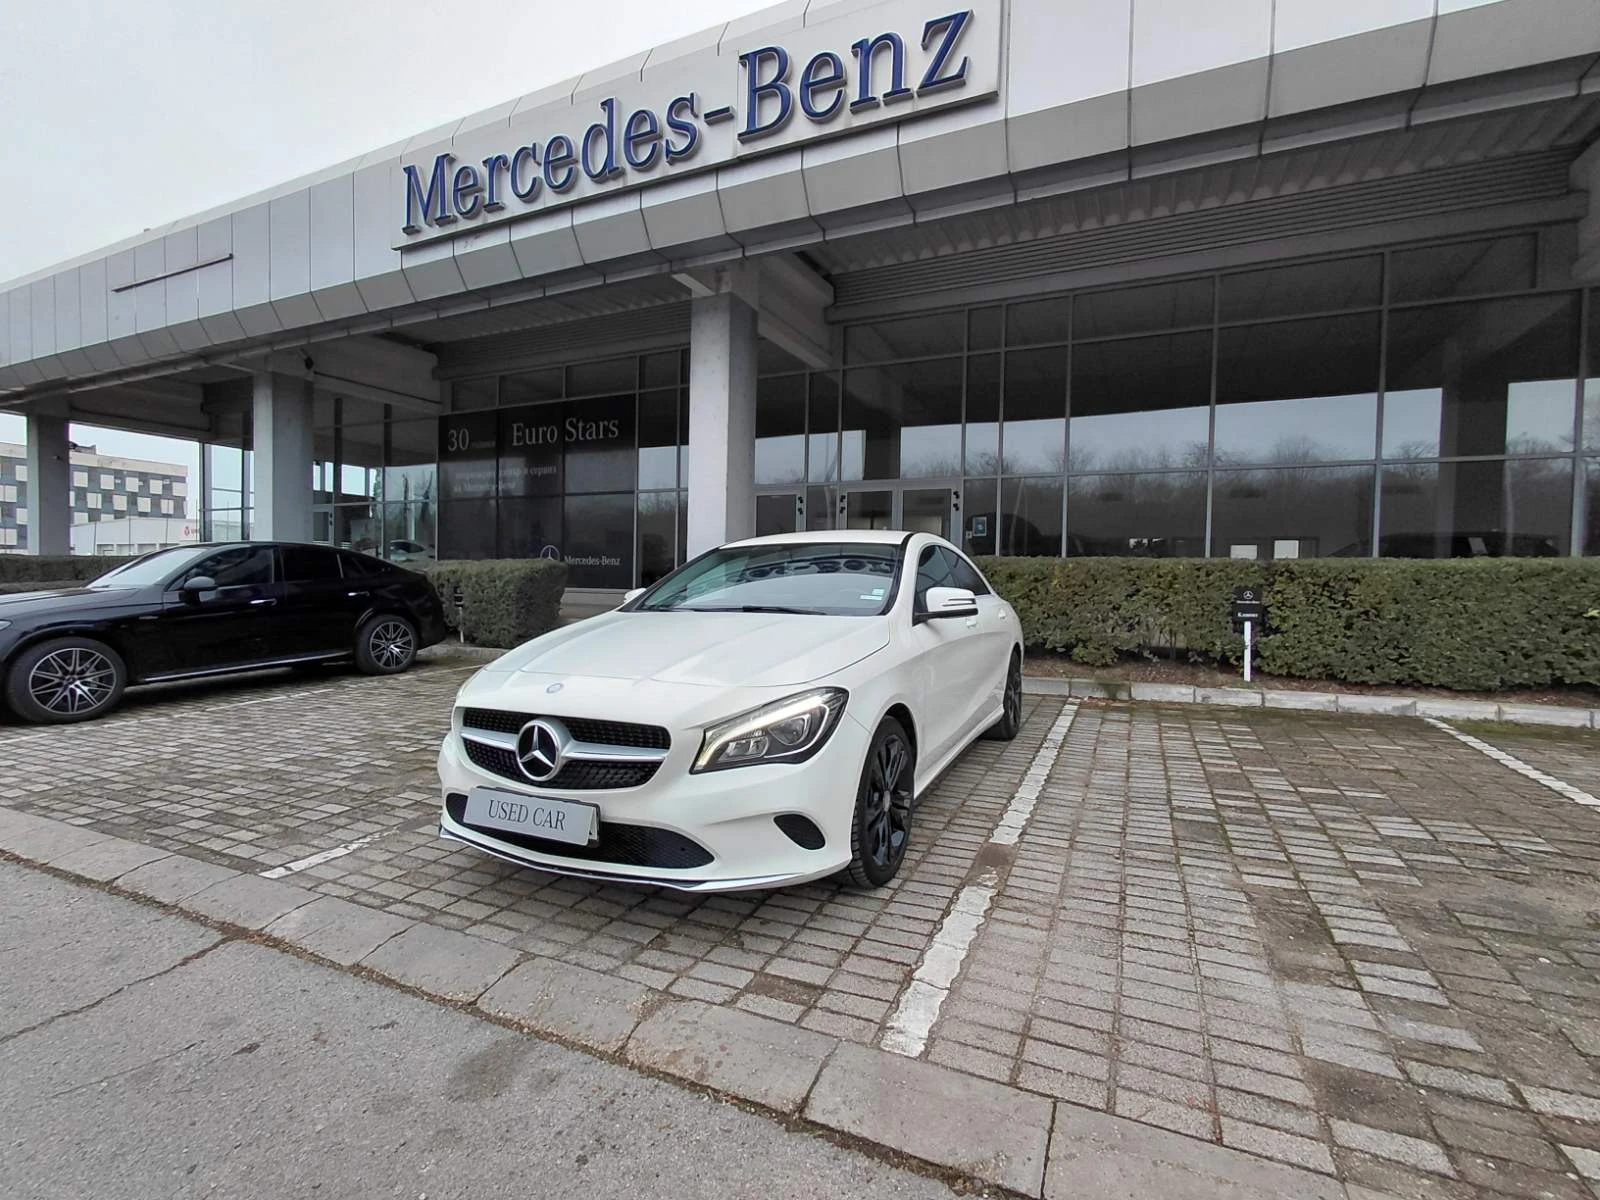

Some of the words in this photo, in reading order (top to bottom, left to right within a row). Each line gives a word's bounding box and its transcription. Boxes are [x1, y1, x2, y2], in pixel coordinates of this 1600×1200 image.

[402, 10, 973, 234] Mercedes-Benz
[448, 428, 469, 452] 30
[511, 422, 558, 446] Euro
[565, 417, 619, 442] Stars
[488, 800, 529, 823] USED
[532, 807, 566, 831] CAR
